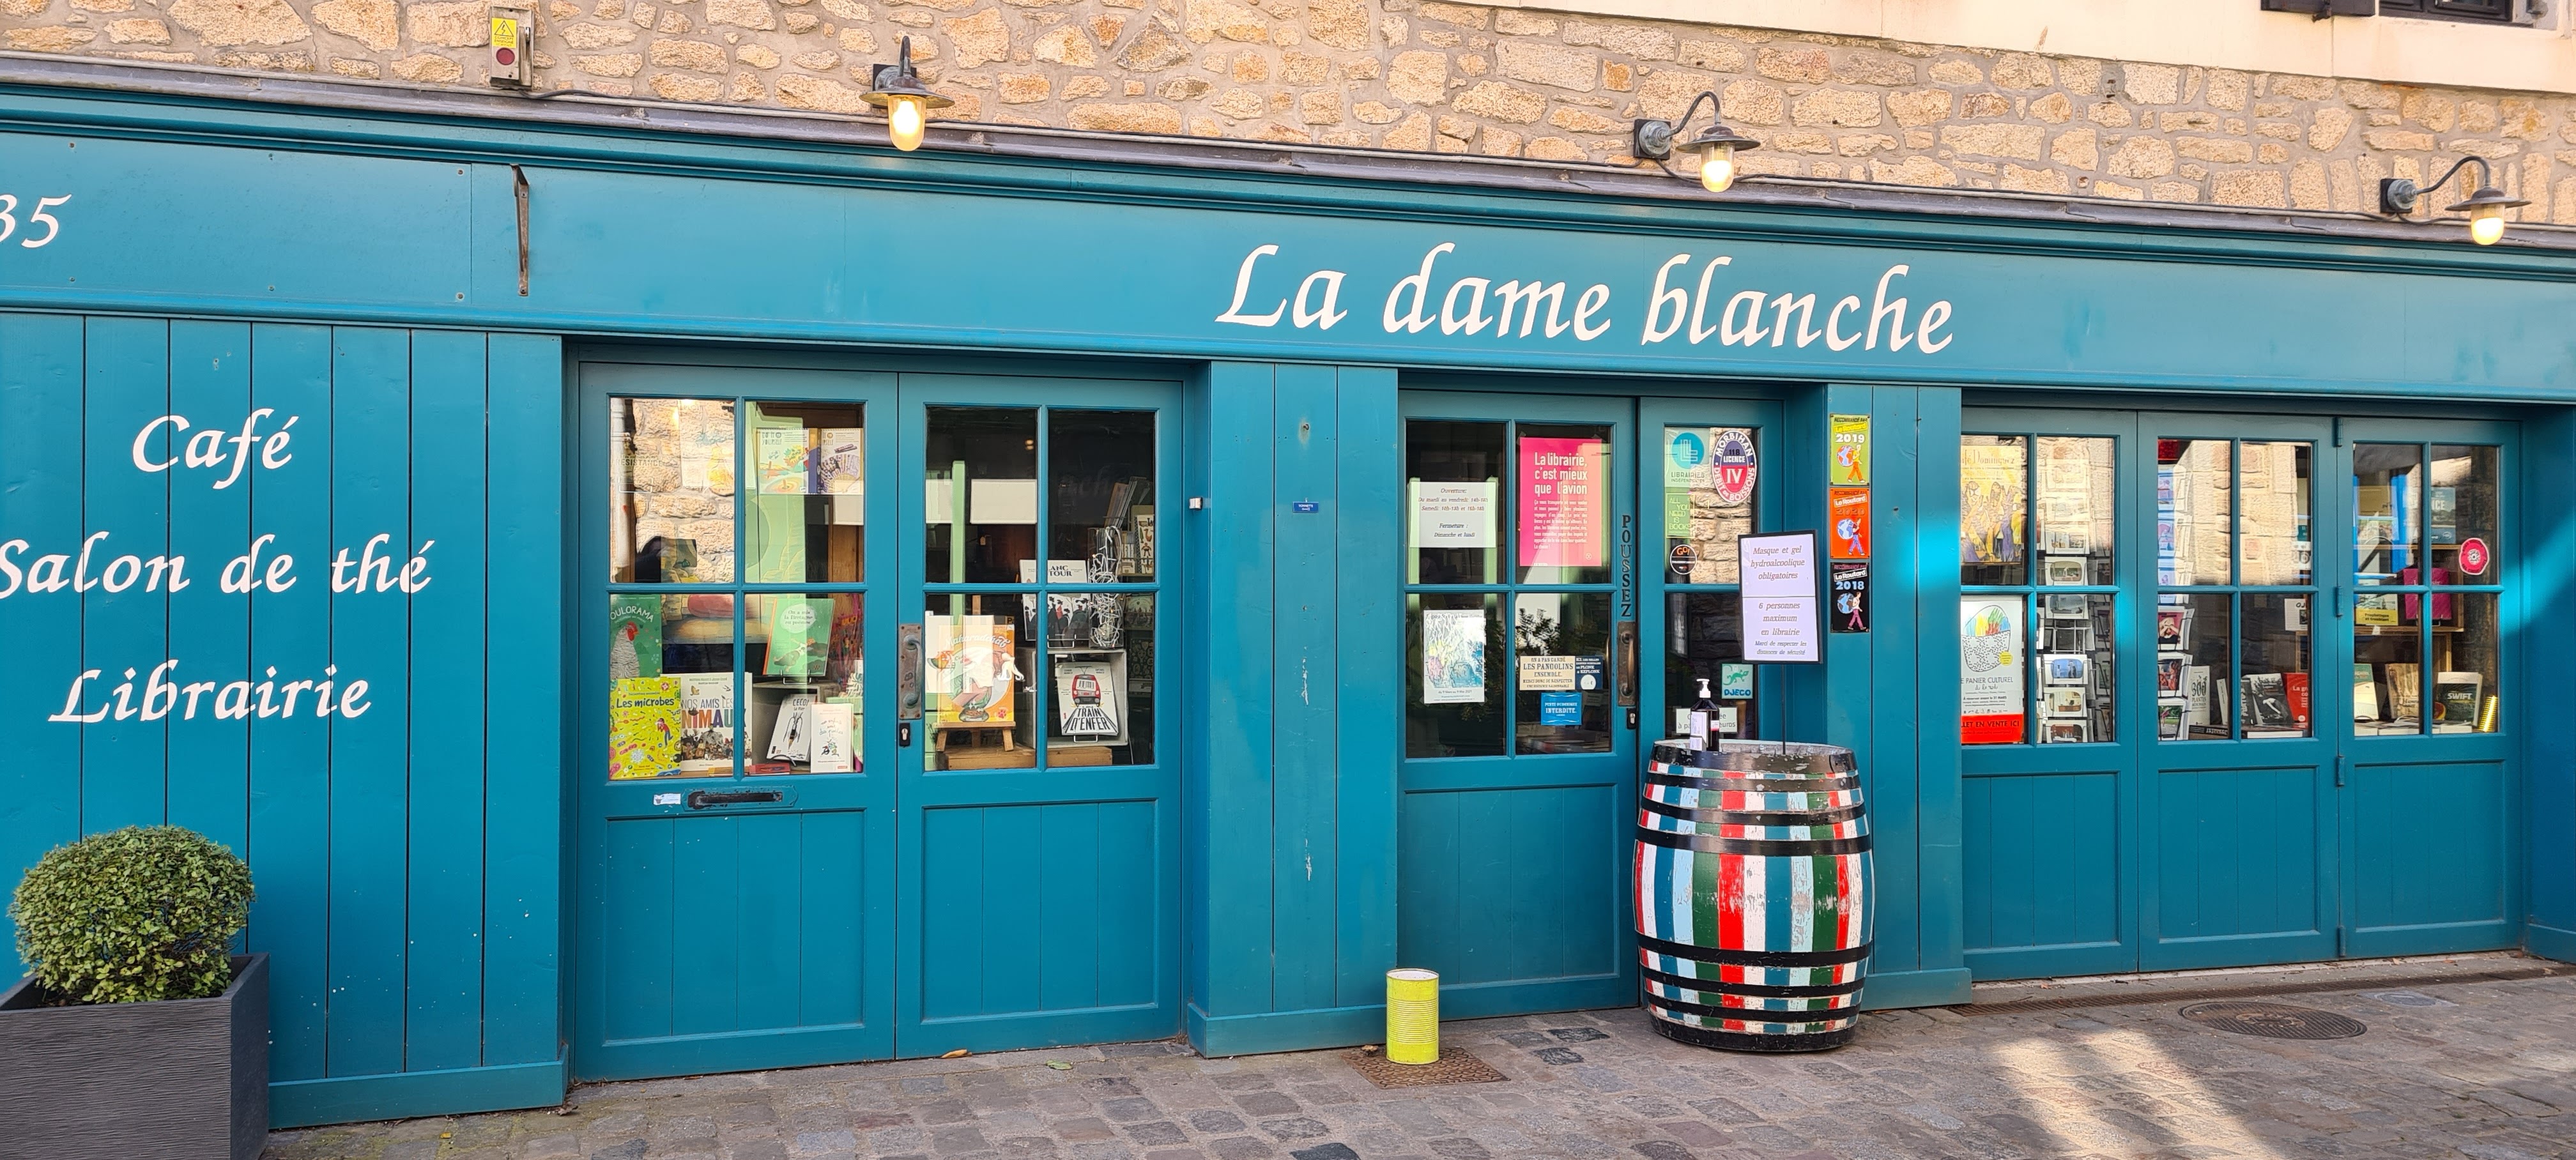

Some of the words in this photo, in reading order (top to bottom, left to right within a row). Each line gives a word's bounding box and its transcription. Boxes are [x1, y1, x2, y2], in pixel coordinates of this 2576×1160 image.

[0, 195, 72, 248] 35
[1215, 245, 1347, 330] La
[1384, 243, 1611, 341] dame
[1642, 254, 1953, 354] blanche
[1715, 432, 1753, 457] MORBIHAN
[1835, 434, 1865, 443] 2019
[133, 409, 299, 489] Café
[1535, 452, 1546, 466] La
[1547, 452, 1588, 467] librairie,
[1535, 467, 1558, 480] c'est
[1560, 468, 1588, 480] mieux
[1726, 468, 1744, 484] IV
[1535, 484, 1552, 498] que
[1557, 481, 1588, 495] l'avion
[1729, 467, 1755, 501] BOISSONS
[1753, 547, 1779, 556] Masque
[1791, 546, 1802, 555] gel
[0, 531, 190, 599] Salon
[221, 535, 296, 593] de
[332, 534, 435, 594] thé
[1621, 515, 1632, 617] POUSSEZ
[1751, 558, 1805, 569] hydroalcoolique
[1758, 572, 1798, 581] obligatoires
[1835, 581, 1865, 590] 2018
[610, 606, 654, 623] OULORAMA
[49, 660, 371, 722] Librairie
[2192, 681, 2207, 696] 300
[617, 698, 632, 708] Les
[634, 696, 675, 708] microbes
[681, 699, 698, 709] NOS
[700, 698, 719, 708] AMIS
[681, 708, 746, 729] NIMAU
[1077, 708, 1102, 717] TRAIN
[1070, 717, 1110, 731] D'ENFER
